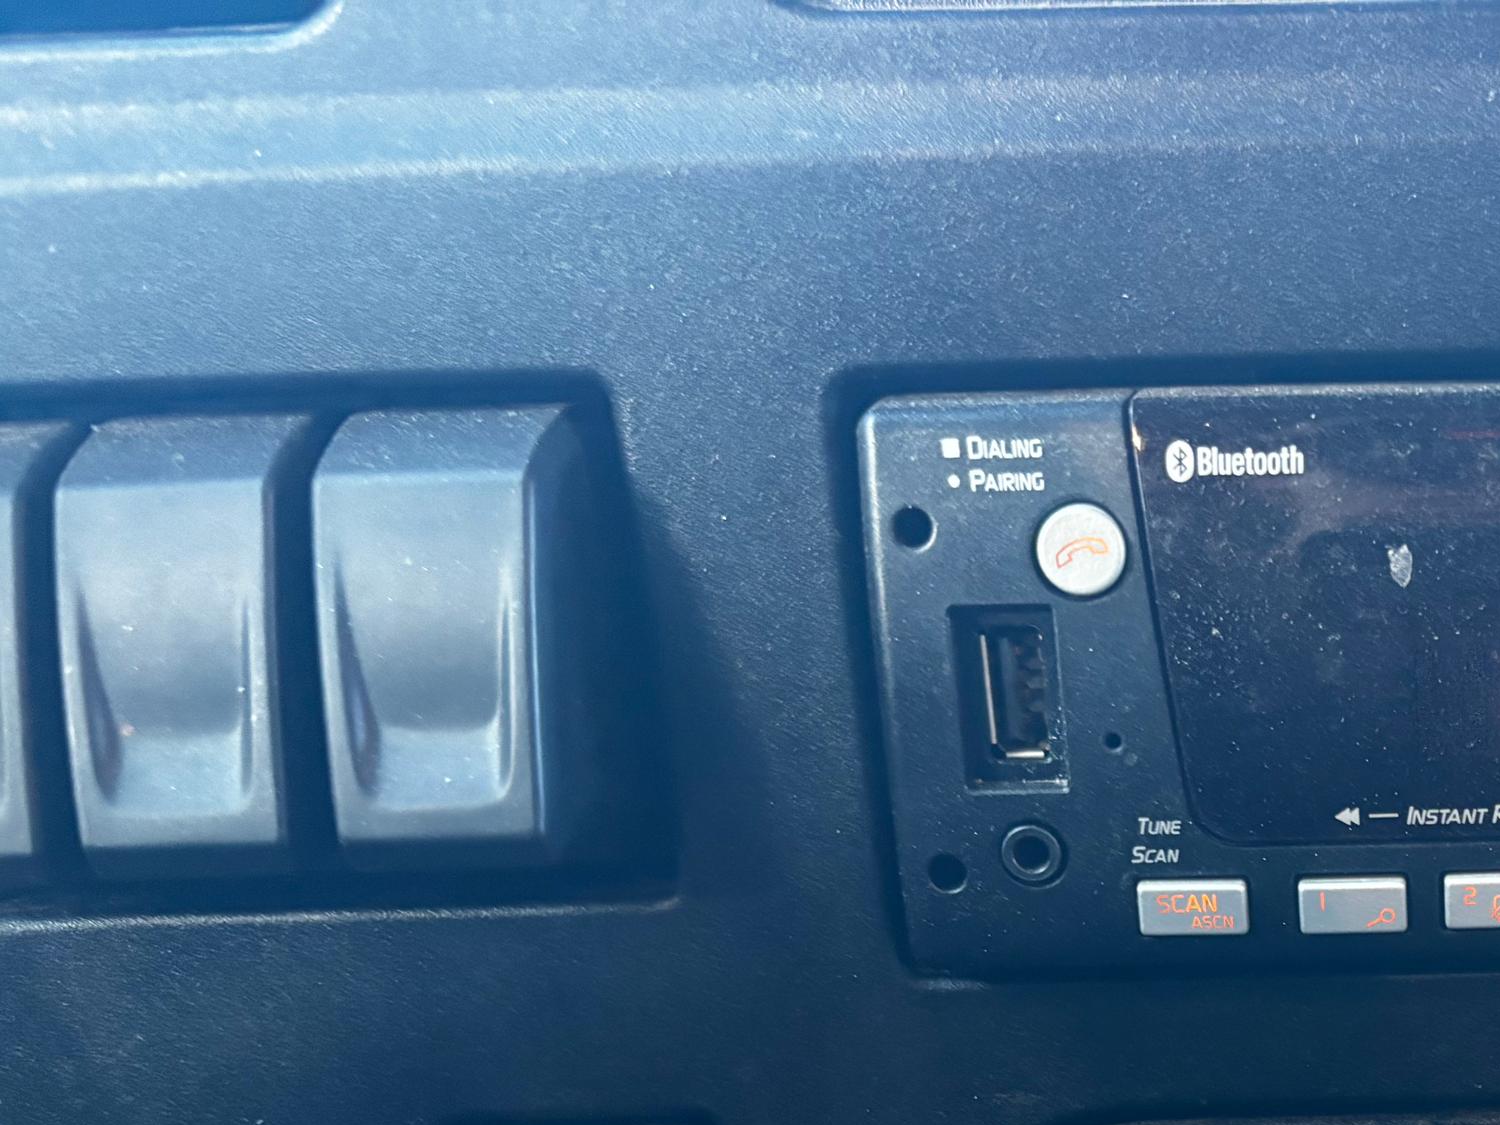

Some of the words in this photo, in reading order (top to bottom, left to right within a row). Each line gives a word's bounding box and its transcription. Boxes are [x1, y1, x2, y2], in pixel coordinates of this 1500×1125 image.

[1197, 445, 1305, 478] Bluetooth
[1155, 893, 1218, 914] SCAN
[1462, 885, 1478, 905] 2
[1190, 914, 1235, 929] ASCN
